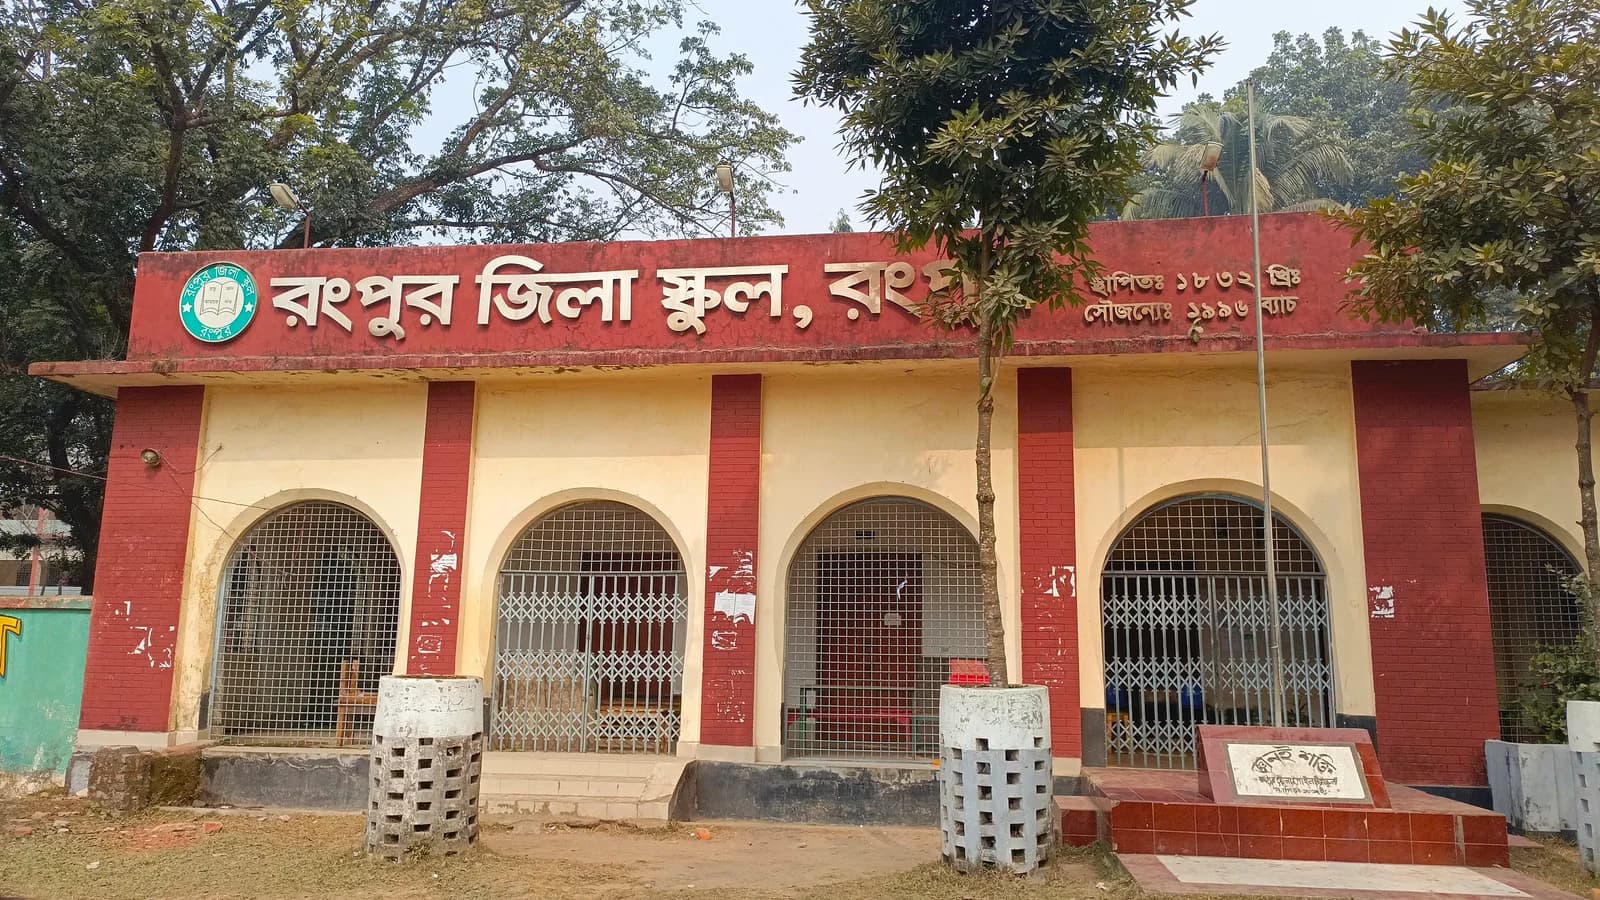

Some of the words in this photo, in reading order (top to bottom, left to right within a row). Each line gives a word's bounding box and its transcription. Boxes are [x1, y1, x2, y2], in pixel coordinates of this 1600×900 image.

[184, 270, 211, 298] রংপুর
[215, 264, 241, 279] জিলা
[1176, 270, 1255, 291] ১৮৩২
[271, 274, 460, 341] রংপুর
[476, 255, 639, 325] জিলা
[657, 263, 813, 335] স্কুল,
[1187, 300, 1249, 320] ১৯৯৬
[1261, 294, 1299, 315] ব্যাচ
[200, 325, 232, 340] রংপুর
[1298, 750, 1337, 774] শক্তি
